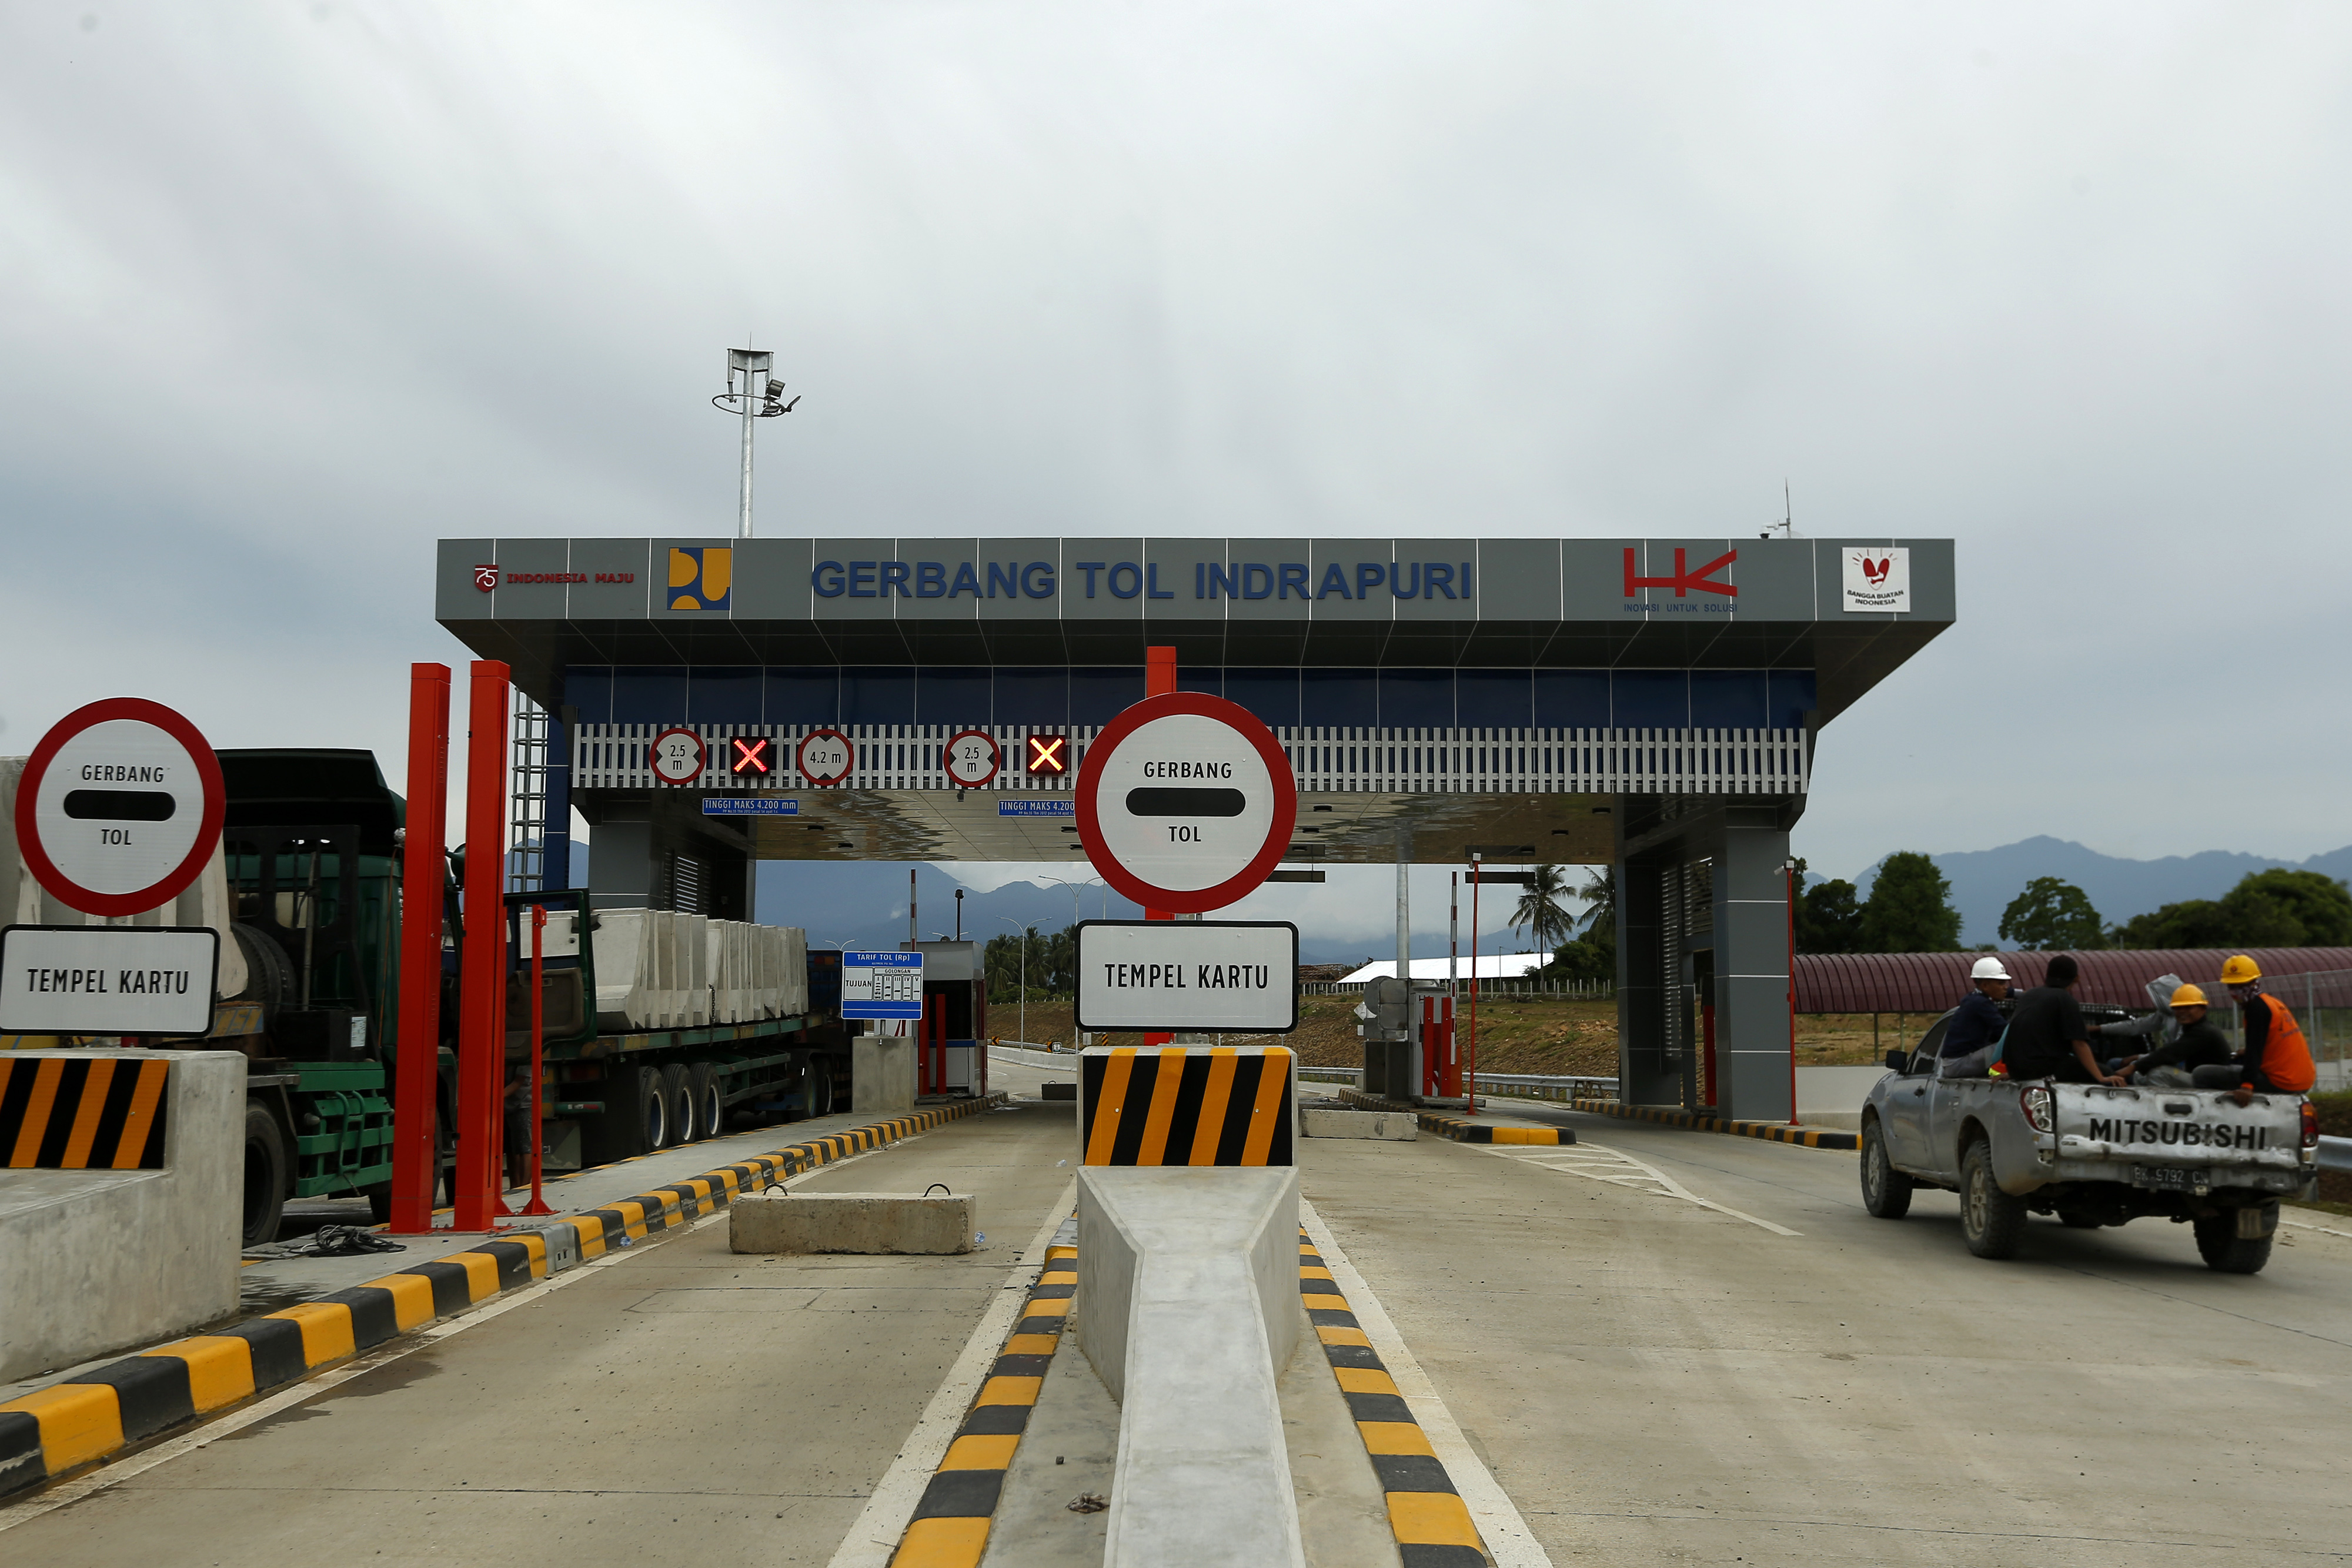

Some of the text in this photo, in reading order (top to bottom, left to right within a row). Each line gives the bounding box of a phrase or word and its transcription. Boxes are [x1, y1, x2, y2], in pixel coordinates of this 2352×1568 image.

[507, 573, 634, 583] INDONESIA MAJU
[1623, 548, 1738, 597] HK
[812, 560, 1471, 599] GERBANG TOL INDRAPURI
[1847, 590, 1904, 599] BANGGA BUATAN
[1624, 604, 1738, 612] INOVASI UNTUK SOLUSI
[670, 744, 686, 757] 2.5
[964, 747, 979, 760] 2.5
[810, 751, 841, 764] 4.2 m
[673, 760, 682, 770] m
[967, 762, 977, 773] m
[1144, 761, 1232, 779] GERBANG
[82, 764, 164, 783] GERBANG
[705, 800, 731, 809] TINGGI
[734, 800, 754, 809] MAKS
[757, 800, 779, 810] 4.200
[1000, 801, 1075, 811] TINGGI MAKS 4.200
[101, 828, 132, 845] TOL
[1168, 825, 1201, 842] TOL
[895, 954, 910, 962] (Rp)
[27, 968, 189, 995] TEMPEL KARTU
[1104, 964, 1268, 989] TEMPEL KARTU
[2089, 1118, 2266, 1150] MITSUBISHI
